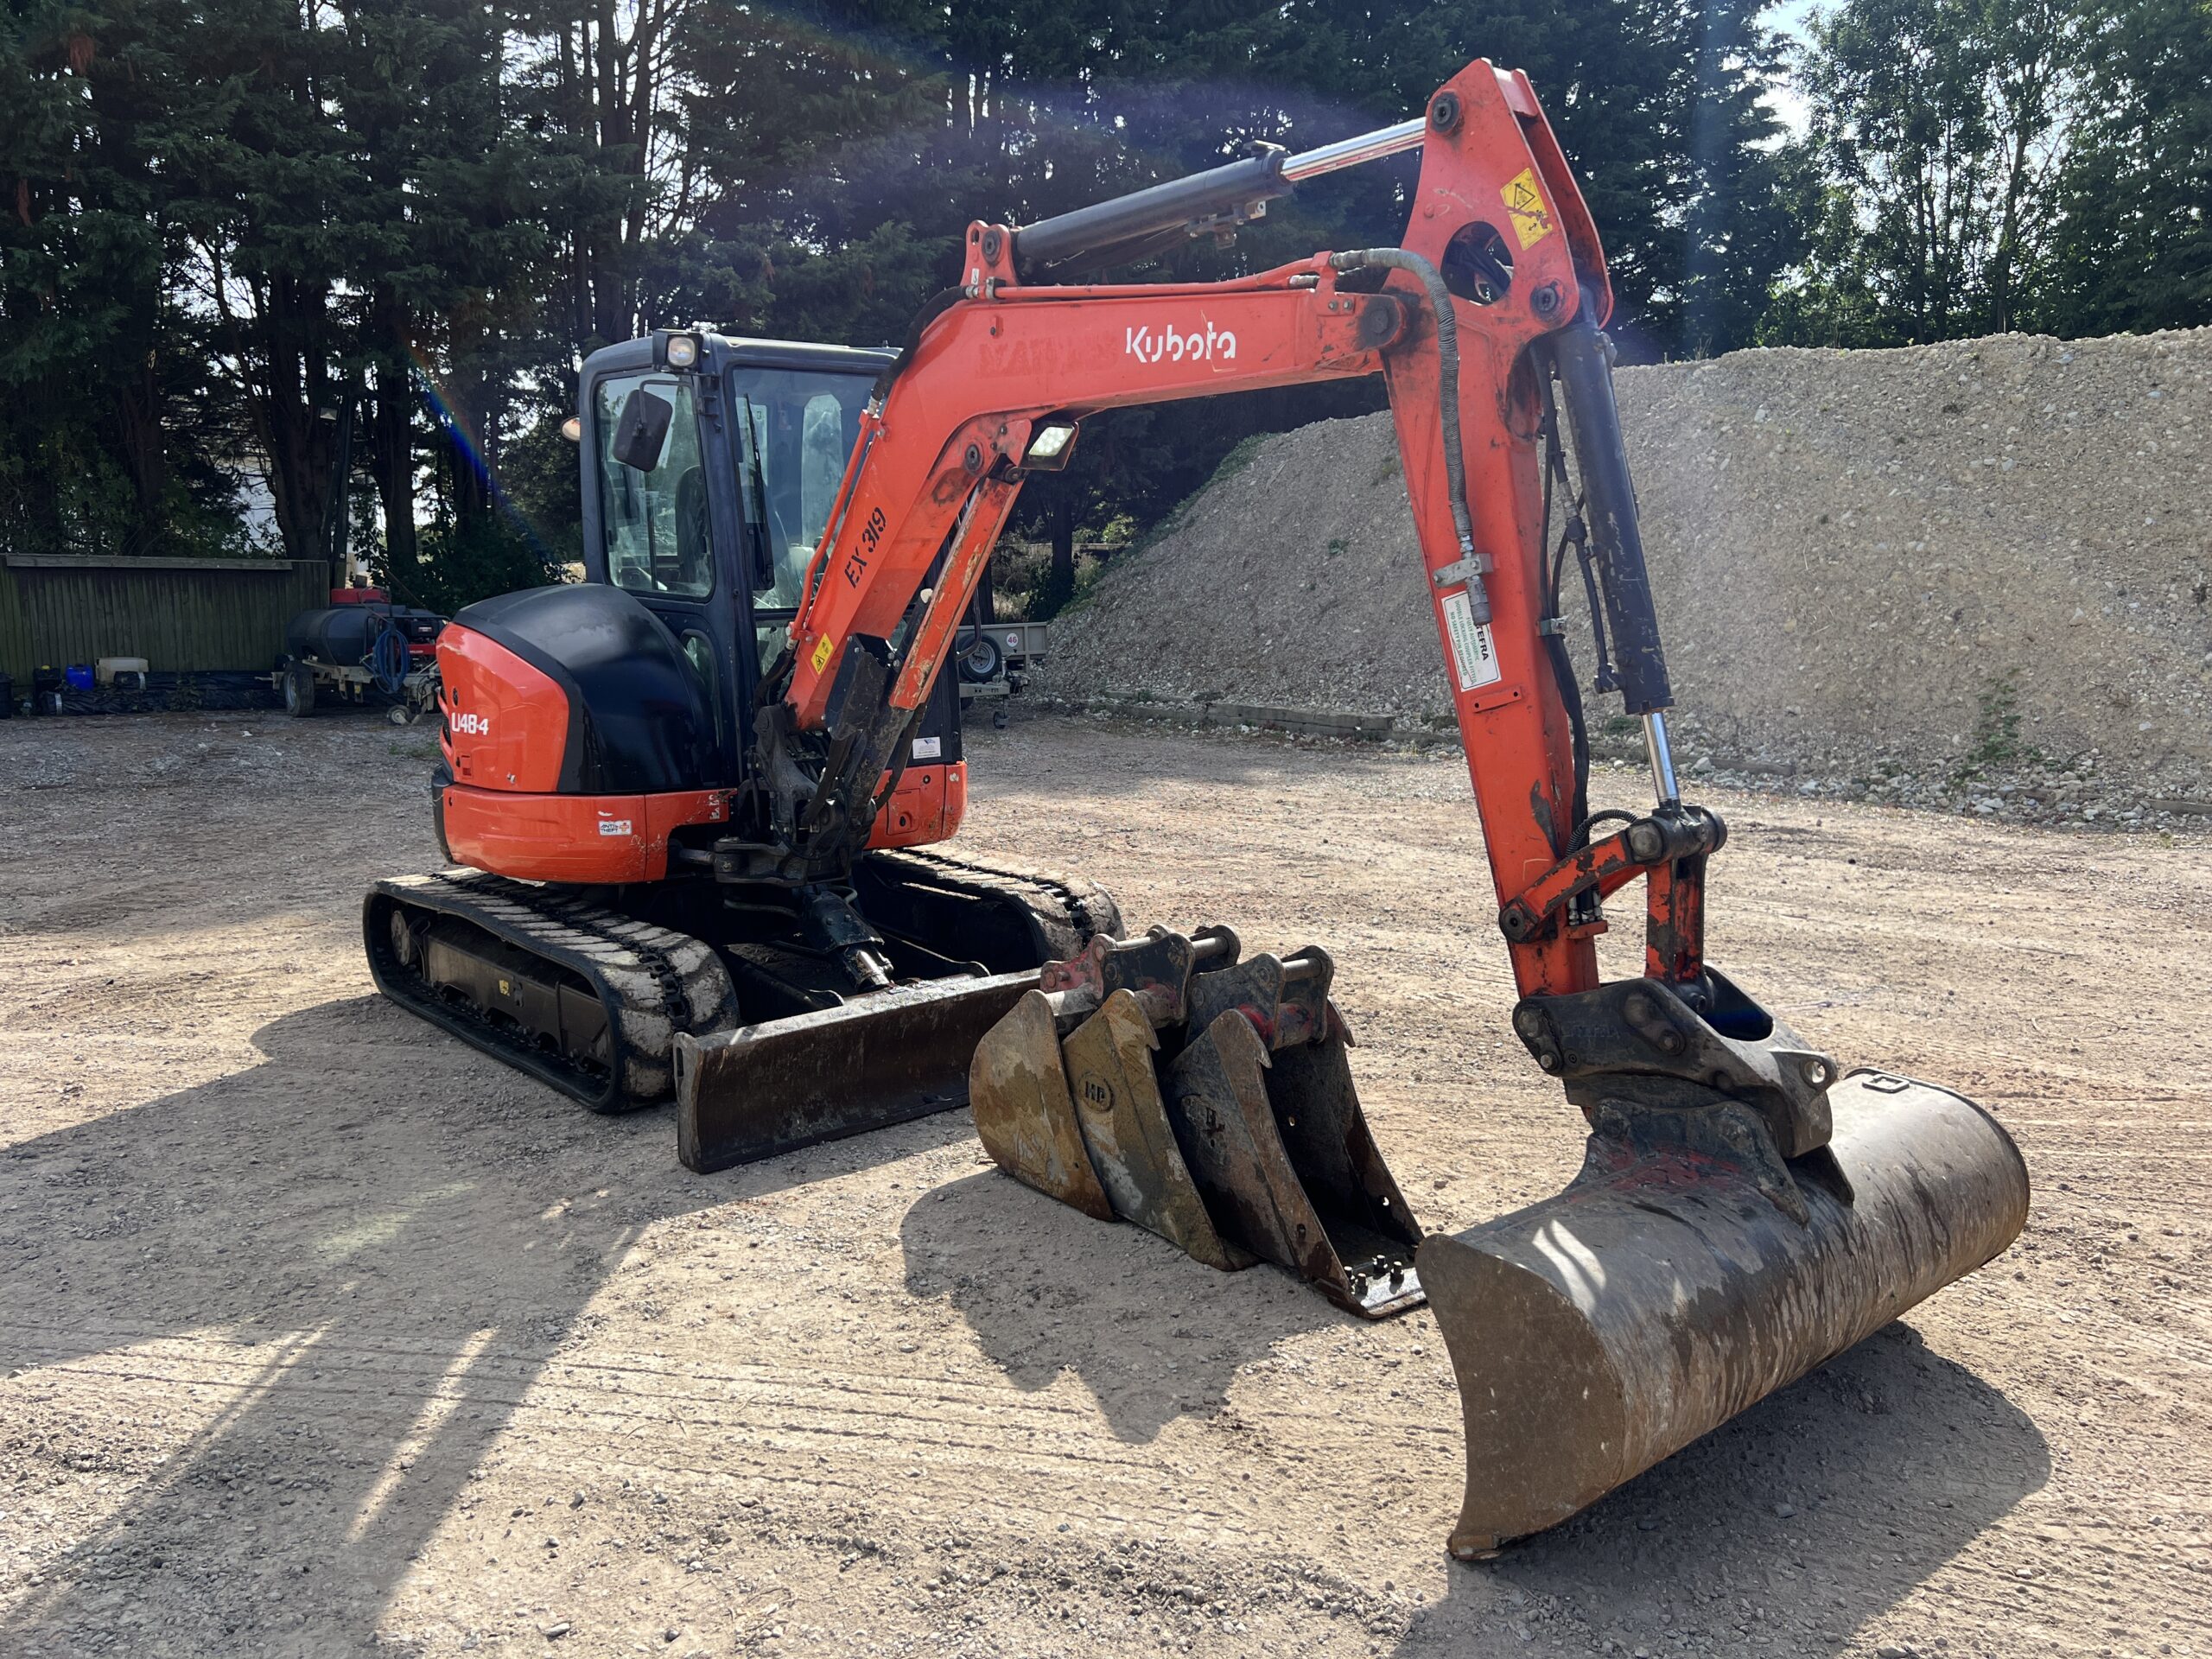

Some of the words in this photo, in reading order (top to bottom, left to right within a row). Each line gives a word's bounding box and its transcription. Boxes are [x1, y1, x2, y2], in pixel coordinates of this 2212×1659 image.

[1125, 321, 1236, 363] Kubota
[844, 546, 868, 589] EX
[861, 506, 887, 553] 319
